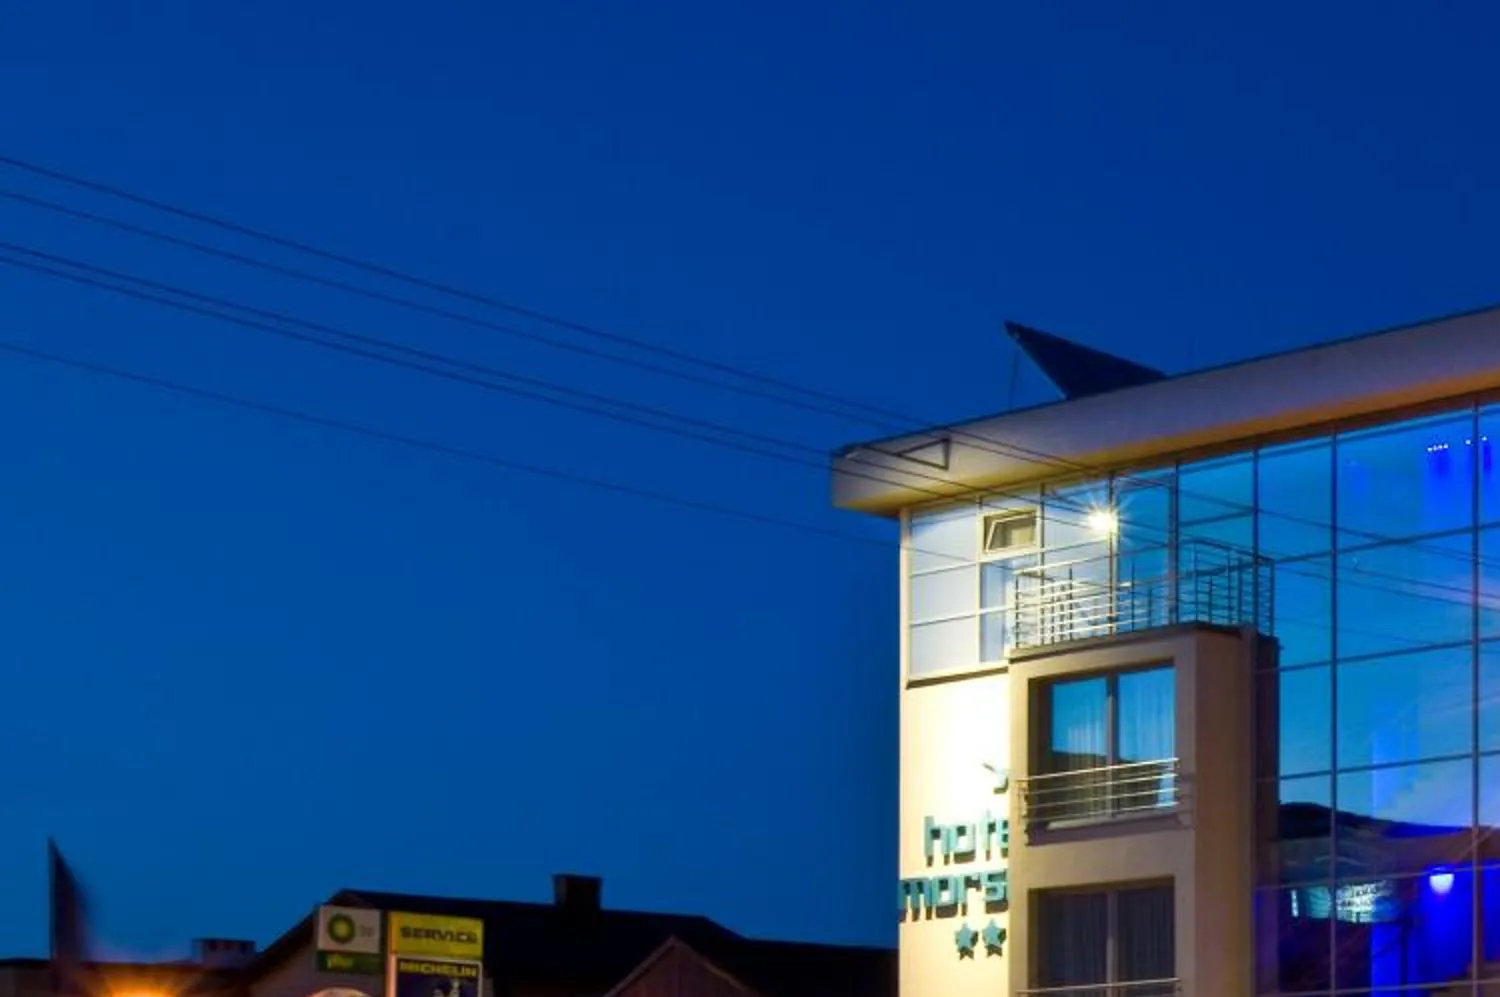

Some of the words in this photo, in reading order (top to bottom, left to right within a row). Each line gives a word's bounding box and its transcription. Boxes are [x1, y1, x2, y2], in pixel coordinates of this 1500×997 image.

[898, 869, 1009, 922] mors
[400, 926, 478, 943] SERVICE
[399, 962, 478, 977] MICHELIN
